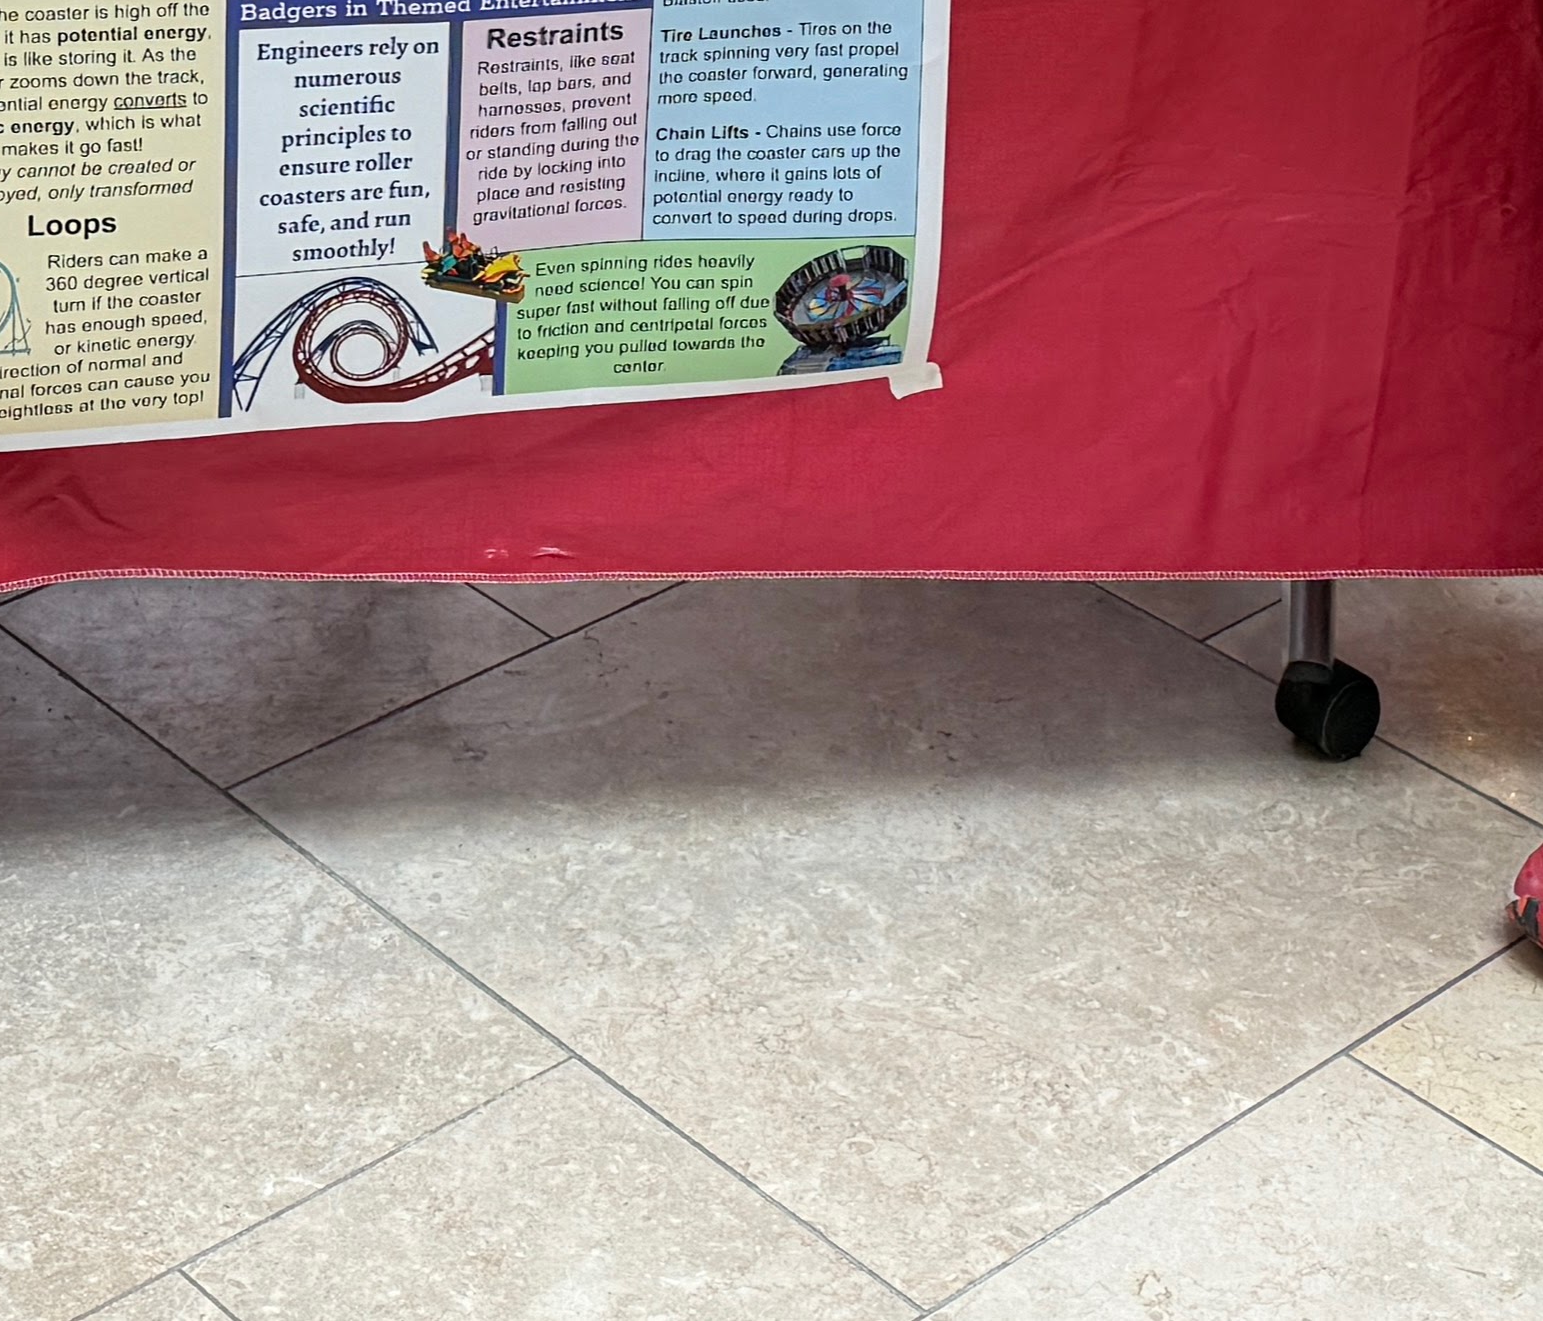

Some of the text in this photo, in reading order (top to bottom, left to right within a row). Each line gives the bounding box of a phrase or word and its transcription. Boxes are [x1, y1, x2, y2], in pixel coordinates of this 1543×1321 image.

[24, 6, 90, 21] coaster
[94, 4, 108, 19] is
[114, 3, 150, 22] high
[155, 1, 179, 17] off
[182, 1, 209, 16] the
[240, 1, 337, 23] Badgers
[4, 29, 14, 44] it
[19, 29, 51, 44] has
[57, 25, 137, 47] potential
[486, 21, 623, 49] Restraints
[3, 51, 17, 67] is
[23, 50, 53, 66] like
[58, 49, 116, 67] storing
[141, 47, 164, 62] As
[169, 46, 196, 61] the
[256, 35, 439, 65] Engineers rely on
[9, 75, 67, 89] zooms
[72, 72, 119, 87] down
[124, 70, 152, 85] the
[156, 68, 204, 85] track,
[293, 70, 401, 88] numerous
[47, 96, 108, 112] energy
[113, 91, 187, 111] converts
[192, 91, 208, 105] to
[298, 93, 395, 118] scientific
[84, 115, 135, 131] which
[141, 114, 155, 129] is
[159, 113, 201, 128] what
[469, 112, 637, 139] riders from falling out
[1, 136, 142, 158] makes it go fast!
[281, 123, 412, 153] principles to
[16, 162, 76, 178] cannot
[80, 161, 102, 176] be
[107, 157, 174, 175] created
[177, 159, 197, 172] or
[278, 151, 413, 176] ensure roller
[47, 183, 85, 202] only
[89, 178, 194, 198] transformed
[258, 179, 430, 207] coasters are fun,
[27, 214, 116, 240] Loops
[277, 209, 411, 234] safe, and run
[47, 247, 207, 269] Riders can make a
[291, 236, 395, 262] smoothly!
[535, 253, 755, 276] Even spinning rides heavily
[45, 266, 209, 291] 360 degree vertical
